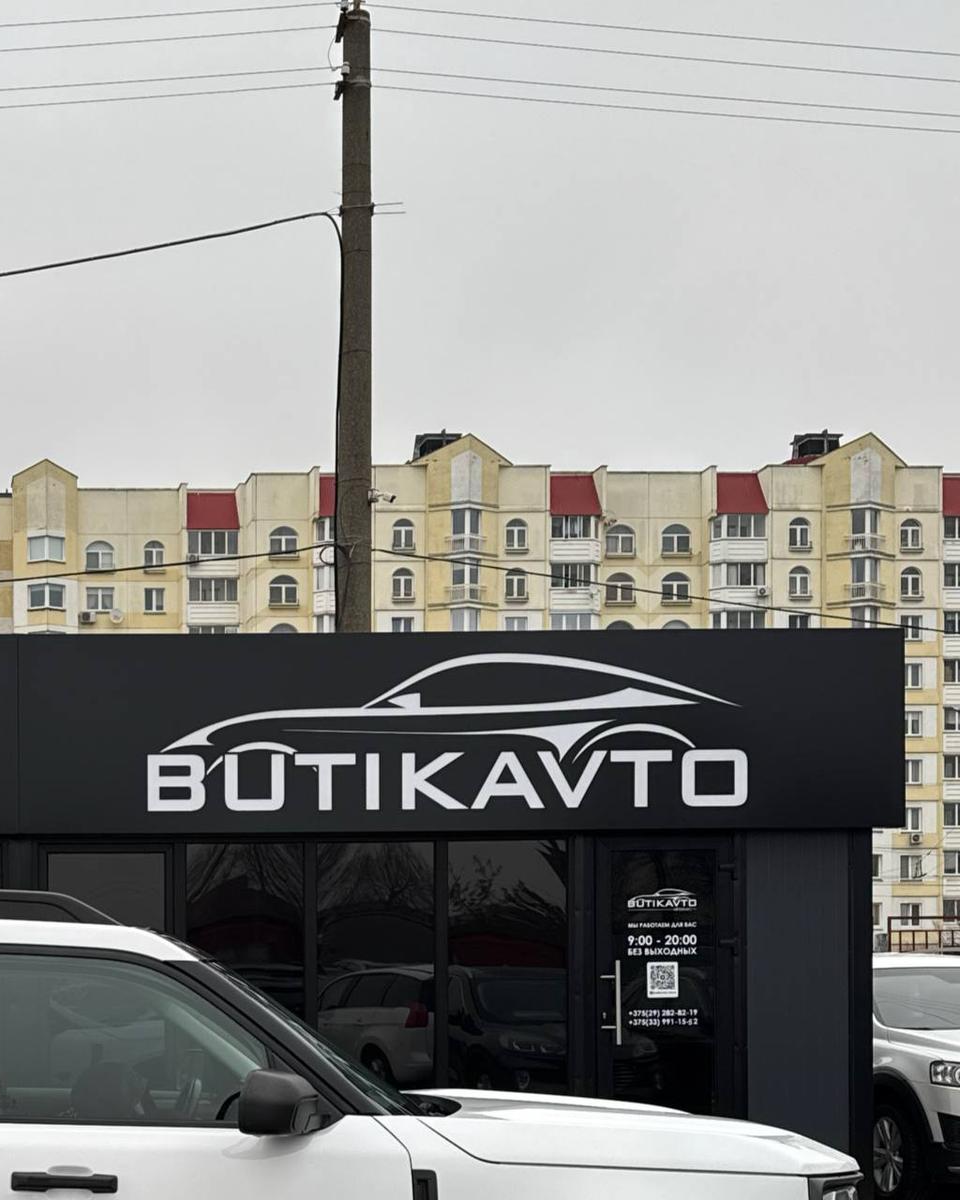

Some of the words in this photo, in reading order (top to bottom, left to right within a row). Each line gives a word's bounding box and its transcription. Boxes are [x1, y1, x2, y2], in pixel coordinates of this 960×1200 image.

[146, 749, 749, 812] BUTIKAVTO
[627, 899, 697, 909] BUTIKAVTO
[627, 935, 653, 946] 9:00
[664, 934, 697, 945] 20:00
[627, 947, 642, 956] БЕЗ
[644, 947, 697, 956] ВЫХОДНЫХ
[628, 1009, 661, 1017] +375(29)
[628, 1018, 661, 1027] +375(33)
